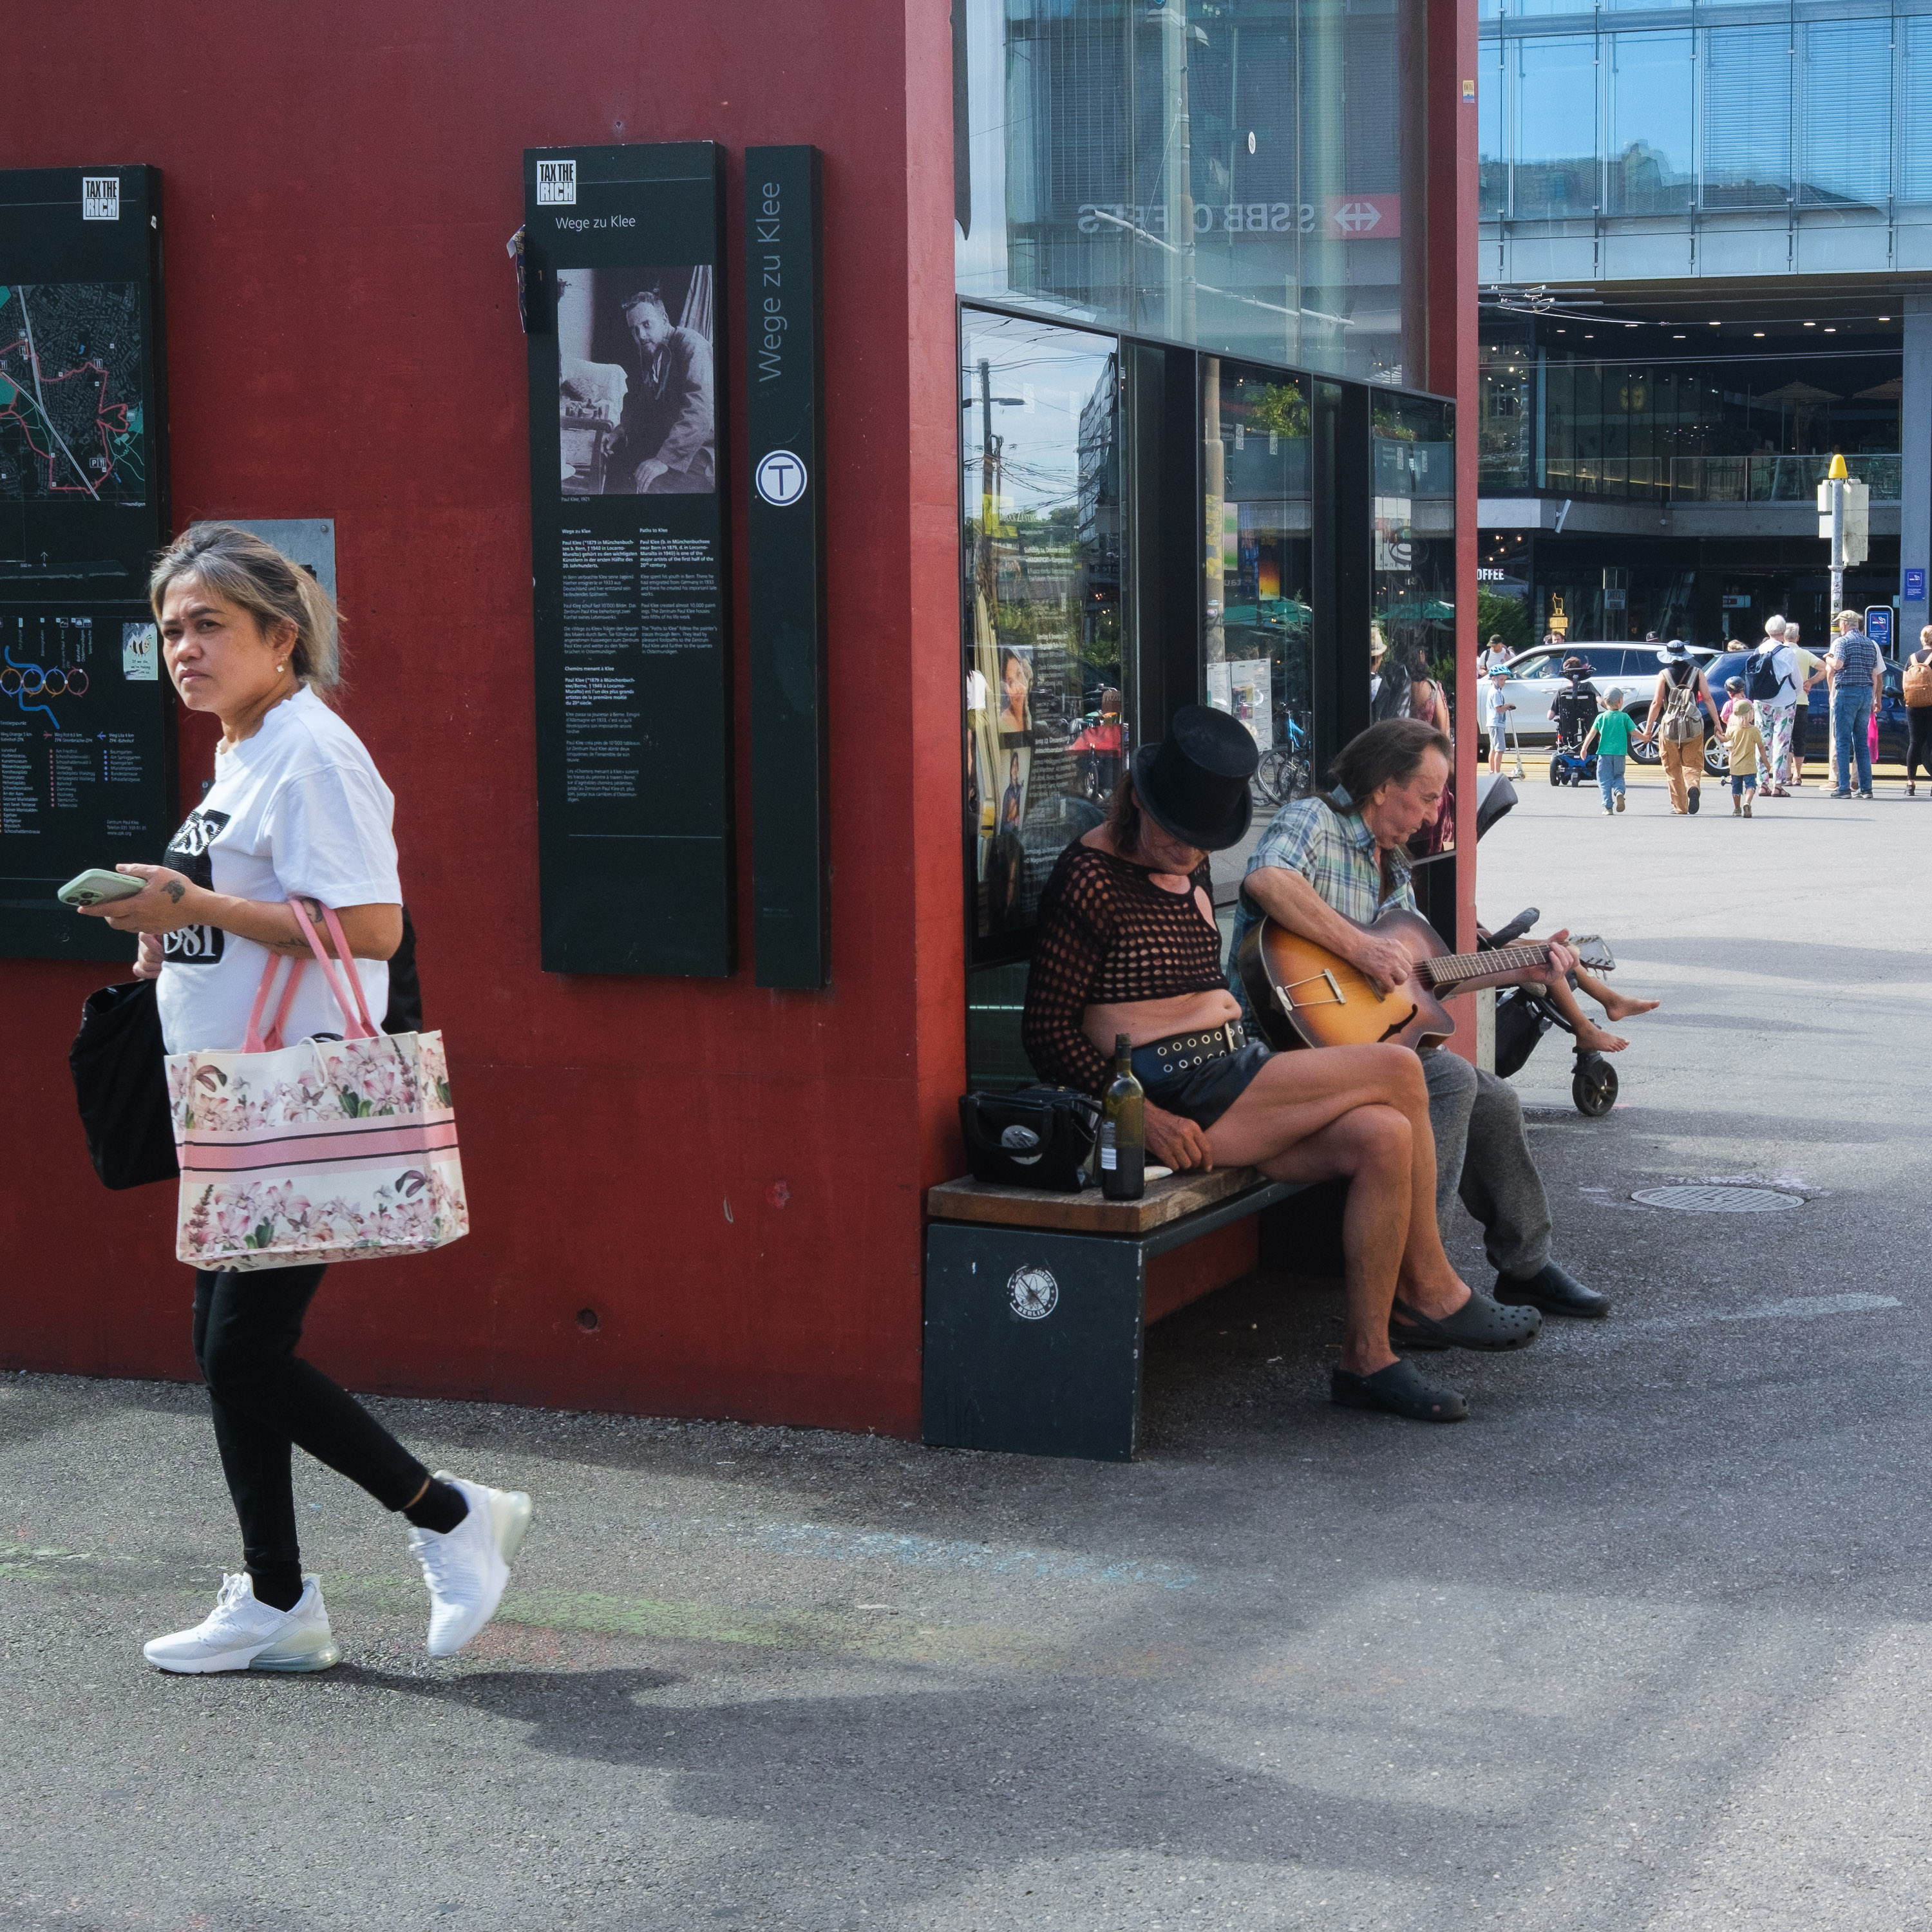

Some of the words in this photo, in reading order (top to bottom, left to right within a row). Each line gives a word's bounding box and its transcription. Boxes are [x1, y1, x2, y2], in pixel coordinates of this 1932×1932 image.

[540, 164, 556, 182] TAX
[558, 164, 574, 182] THE
[86, 181, 100, 198] TAX
[102, 180, 117, 197] THE
[540, 182, 573, 202] RICH
[86, 198, 116, 218] RICH
[756, 182, 781, 243] Klee
[556, 217, 589, 229] Wege
[594, 218, 607, 228] zu
[611, 215, 636, 227] Klee
[762, 254, 781, 287] zu
[759, 299, 787, 383] Wege
[768, 465, 793, 496] T
[1477, 568, 1504, 580] OFFEE
[1018, 1306, 1046, 1316] BERLIN
